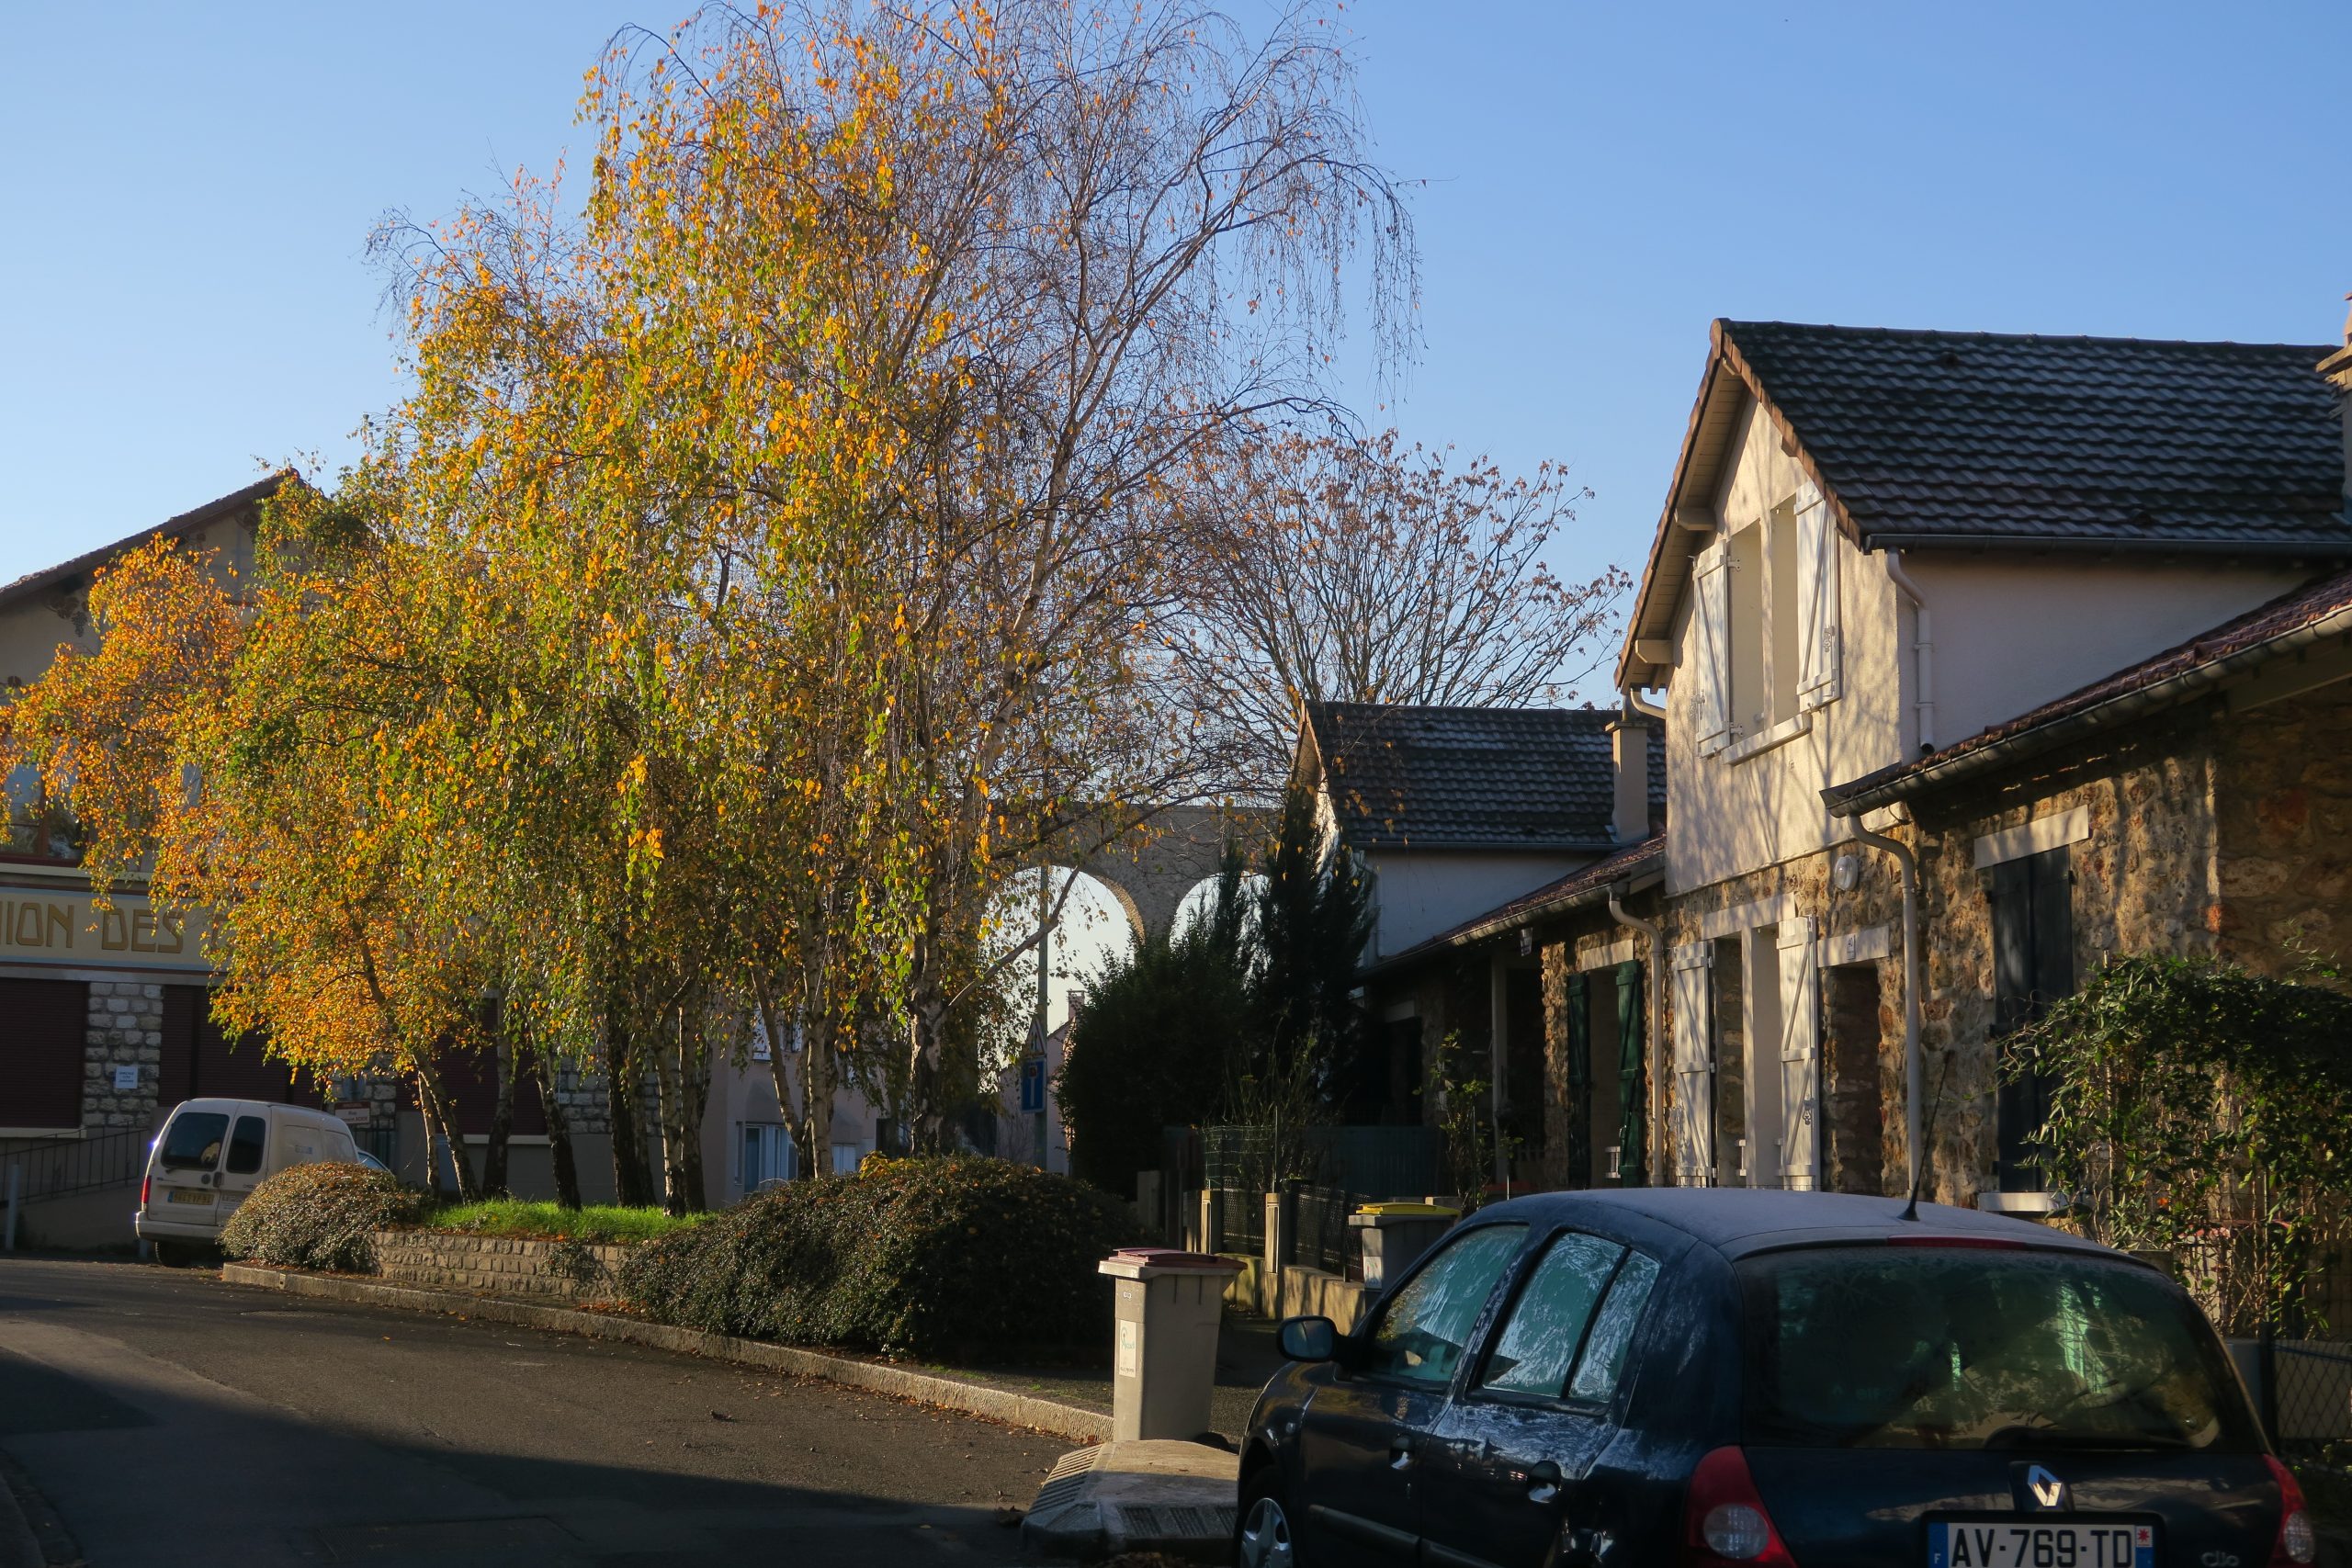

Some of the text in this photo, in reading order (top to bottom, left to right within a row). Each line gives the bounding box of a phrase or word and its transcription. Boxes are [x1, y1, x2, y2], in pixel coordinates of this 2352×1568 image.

[0, 900, 74, 948] ION
[101, 908, 185, 953] DES
[1934, 1553, 1941, 1564] F
